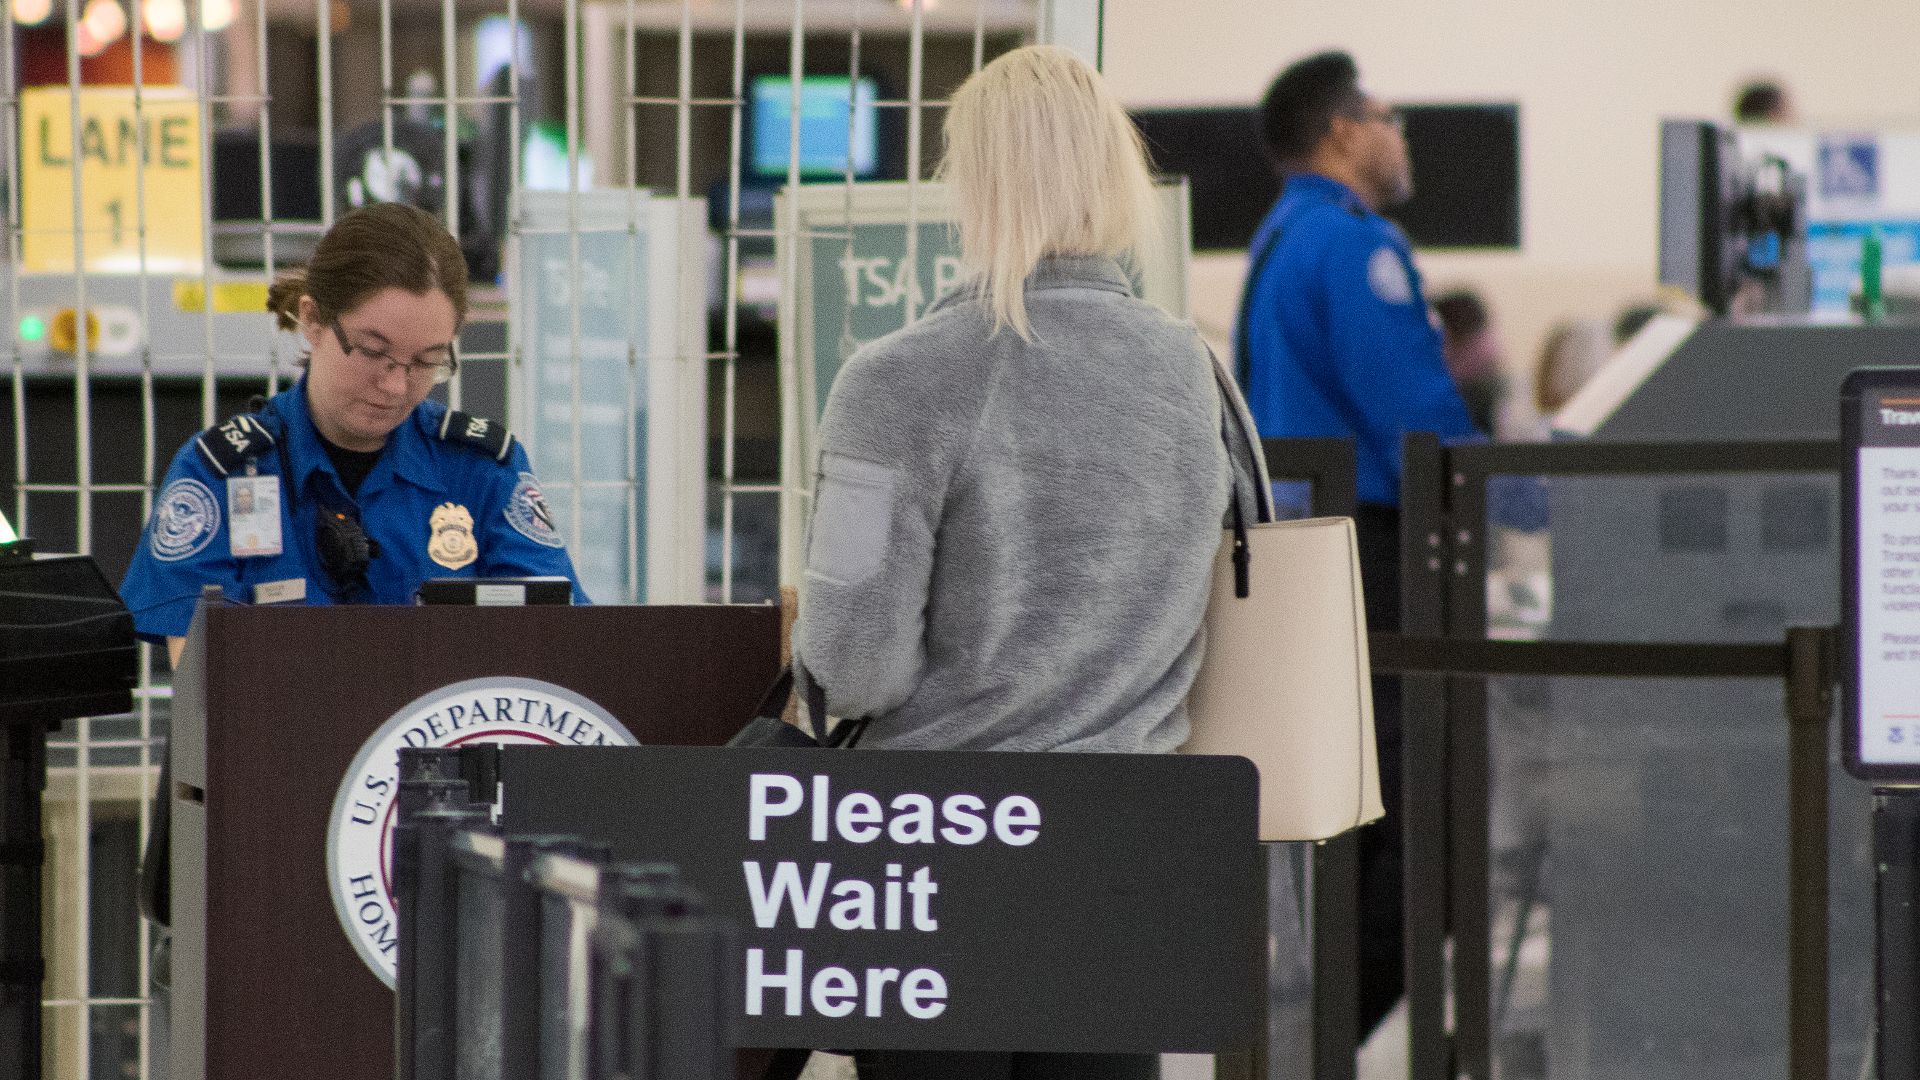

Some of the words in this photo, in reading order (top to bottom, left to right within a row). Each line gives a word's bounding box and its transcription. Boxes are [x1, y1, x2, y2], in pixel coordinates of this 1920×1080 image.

[39, 114, 194, 168] LANE
[106, 200, 122, 245] 1
[839, 257, 924, 306] TSA
[219, 420, 250, 453] TSA
[465, 416, 489, 437] TSA
[351, 774, 395, 826] U.S.
[748, 773, 1042, 847] Please
[350, 875, 397, 962] HOM
[743, 861, 939, 932] Wait
[745, 948, 949, 1019] Here
